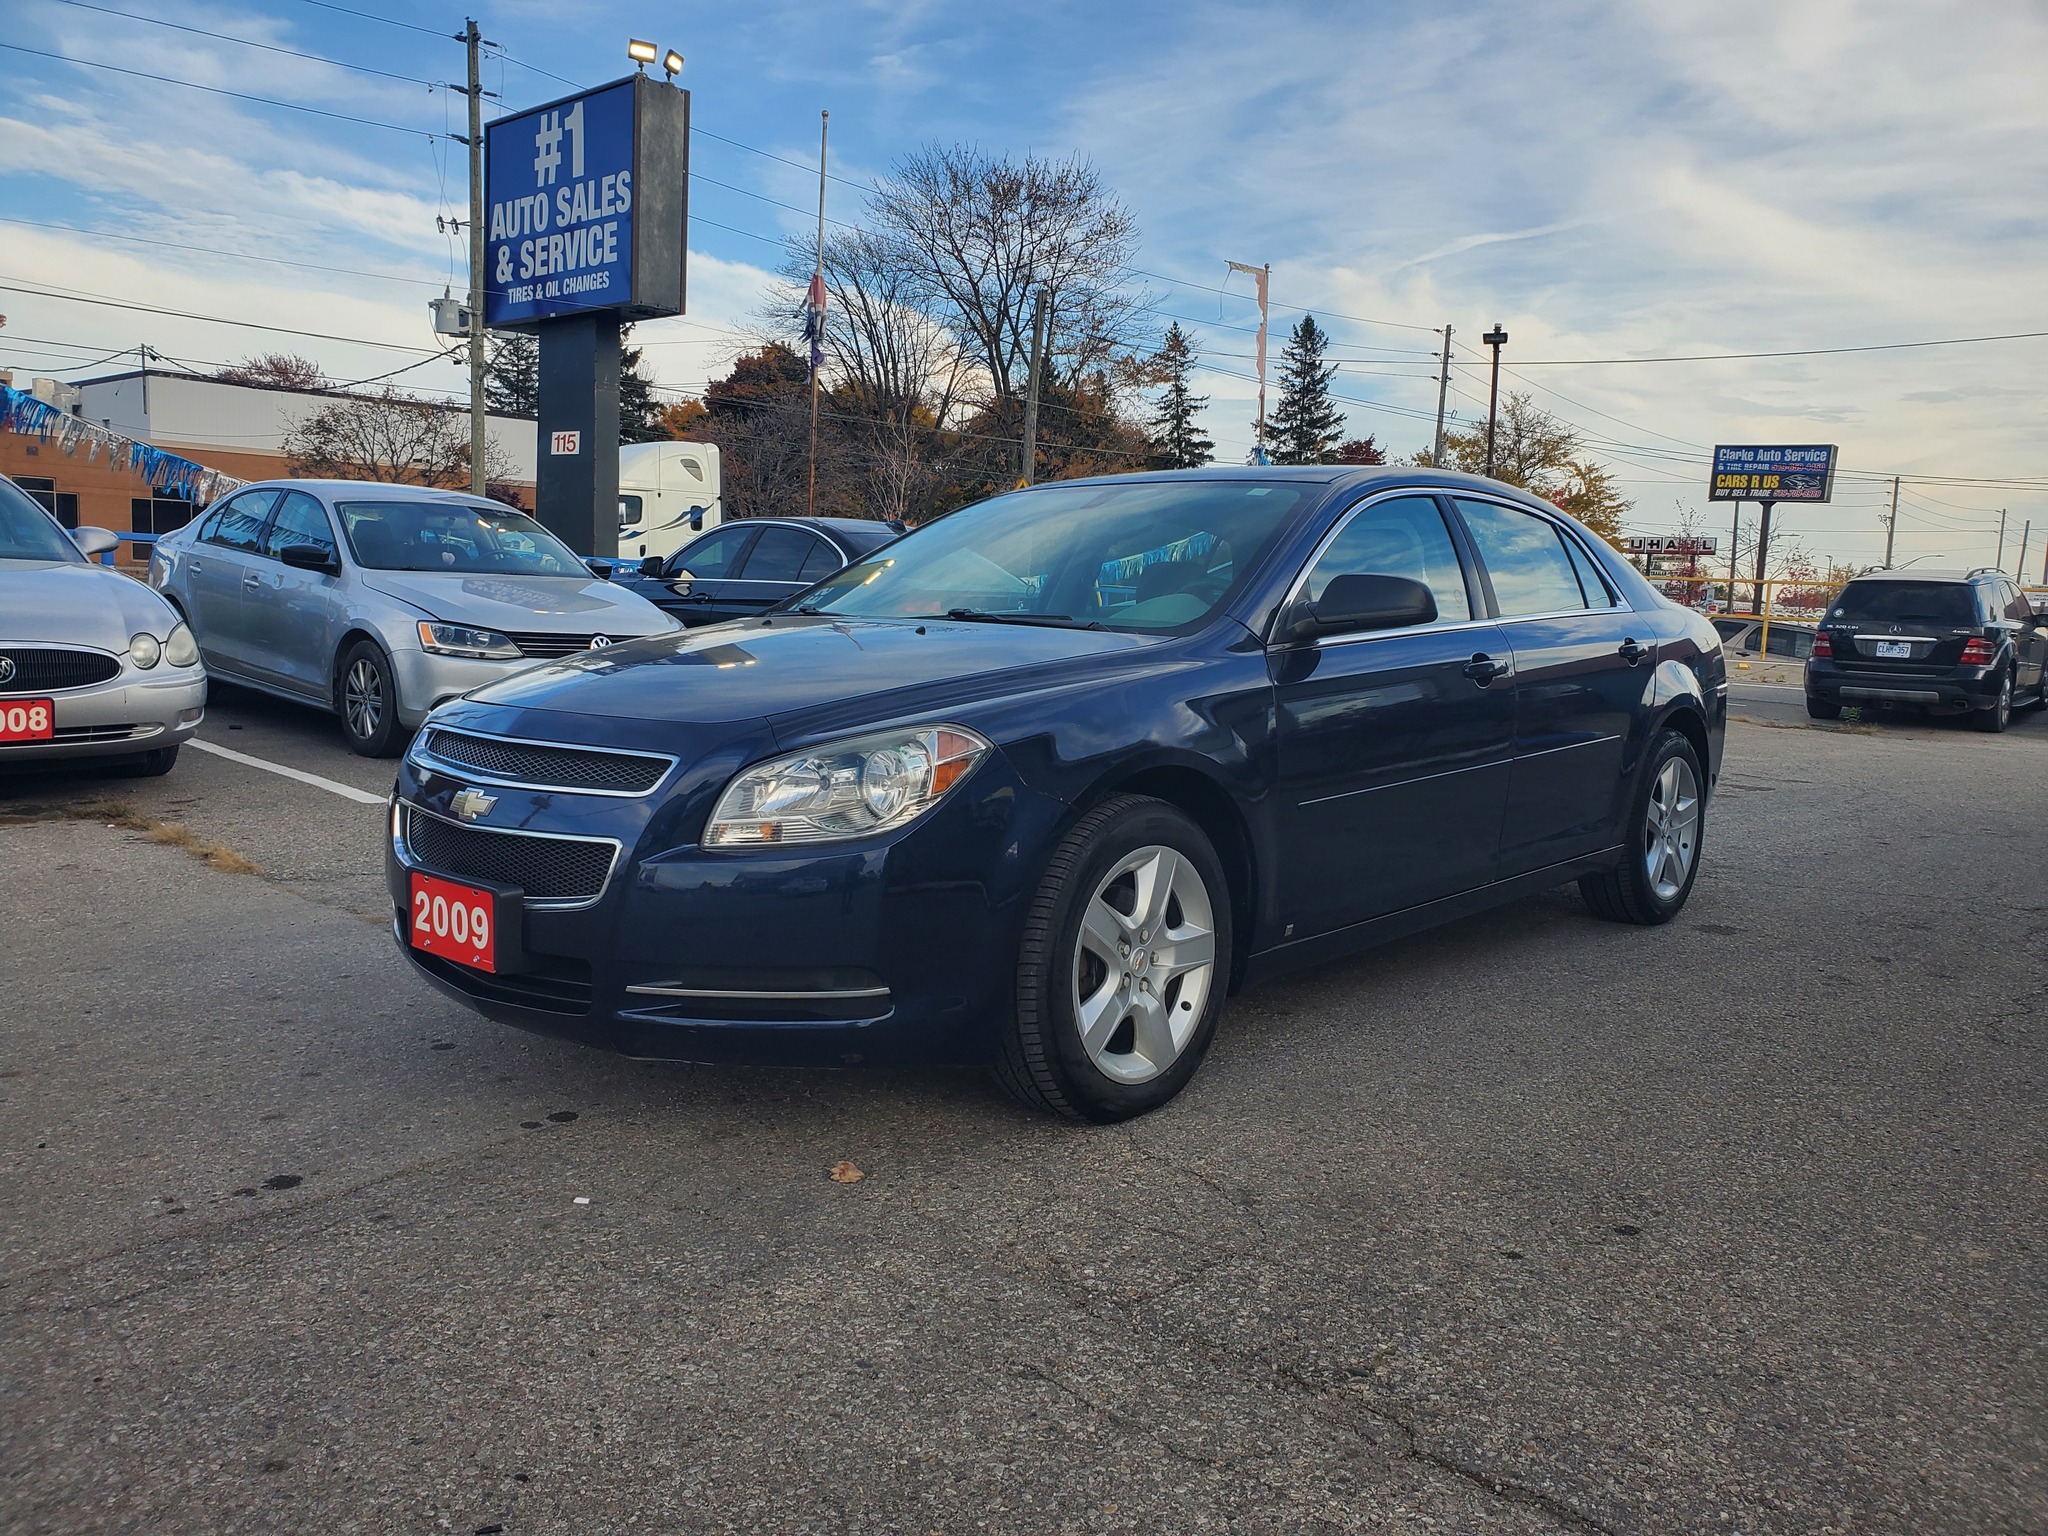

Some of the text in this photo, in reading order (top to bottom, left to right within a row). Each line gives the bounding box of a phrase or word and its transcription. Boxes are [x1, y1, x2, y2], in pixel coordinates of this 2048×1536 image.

[534, 101, 585, 188] #1
[489, 170, 632, 242] AUTO SALES
[496, 221, 618, 284] & SERVICE
[507, 271, 610, 304] TIRES & OIL CHANGES
[554, 434, 577, 452] 115
[1719, 448, 1827, 462] Clarke Auto Service
[1718, 463, 1724, 471] &
[1726, 463, 1742, 471] TIRE
[1743, 463, 1770, 471] REPAIR
[1716, 474, 1780, 489] CARS R US
[1731, 489, 1748, 497] SELL
[1749, 489, 1772, 497] TRADE
[0, 706, 48, 733] 08
[415, 890, 489, 950] 2009
